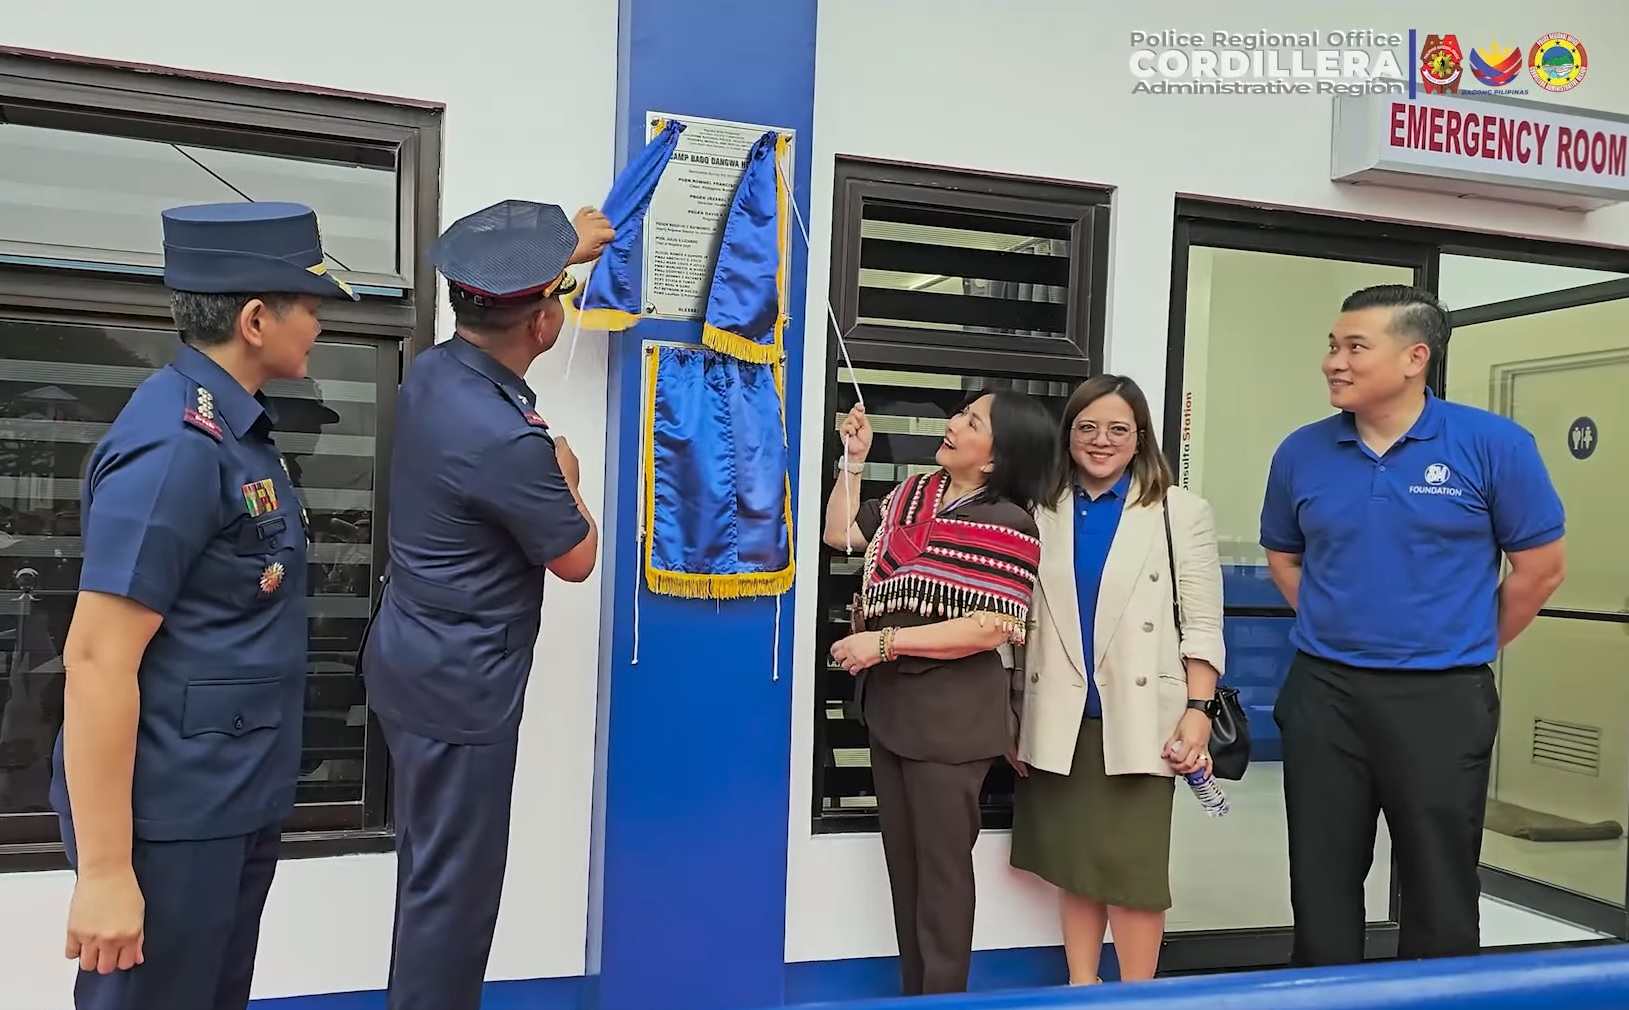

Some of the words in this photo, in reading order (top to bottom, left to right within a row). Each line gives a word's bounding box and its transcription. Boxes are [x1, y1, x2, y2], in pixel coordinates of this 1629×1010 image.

[1390, 102, 1550, 166] EMERGENCY
[1556, 125, 1627, 177] ROOM
[690, 154, 709, 165] BADO
[711, 156, 740, 169] DANGWA
[1182, 392, 1192, 441] Station
[1409, 485, 1462, 496] FOUNDATION
